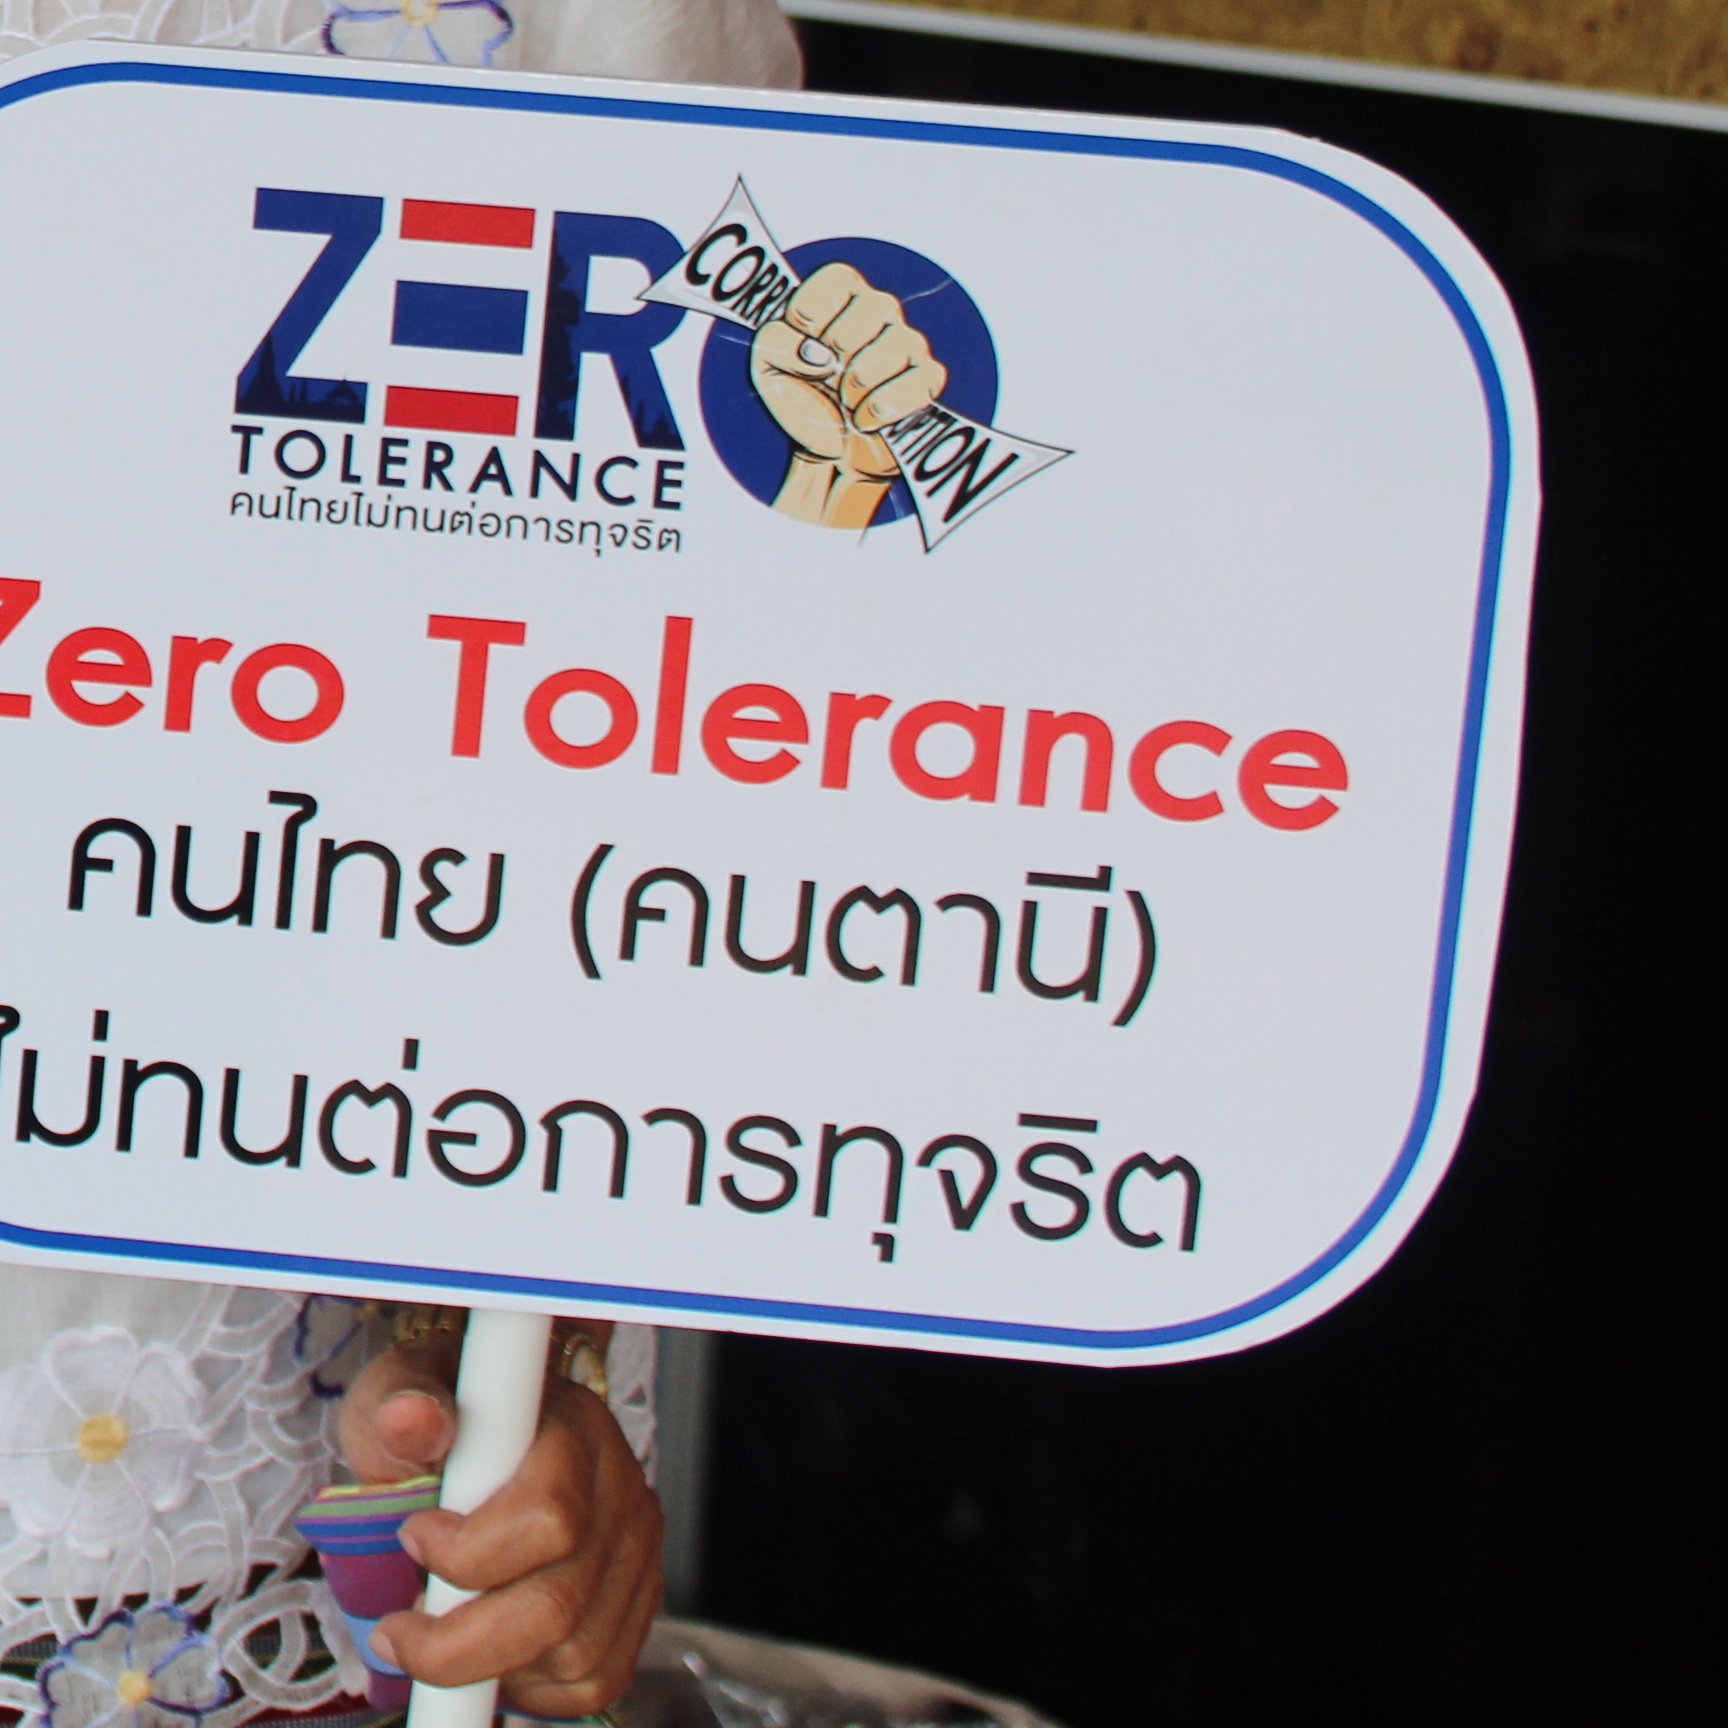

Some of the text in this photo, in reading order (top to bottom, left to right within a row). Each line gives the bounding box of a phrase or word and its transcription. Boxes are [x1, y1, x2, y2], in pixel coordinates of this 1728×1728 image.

[231, 424, 686, 511] TOLERANCE
[231, 486, 682, 556] คนไทยไม่ทนต่อการทุจริต
[427, 613, 1350, 831] Tolerance
[67, 789, 1157, 1028] คนไทย (คนตานี)
